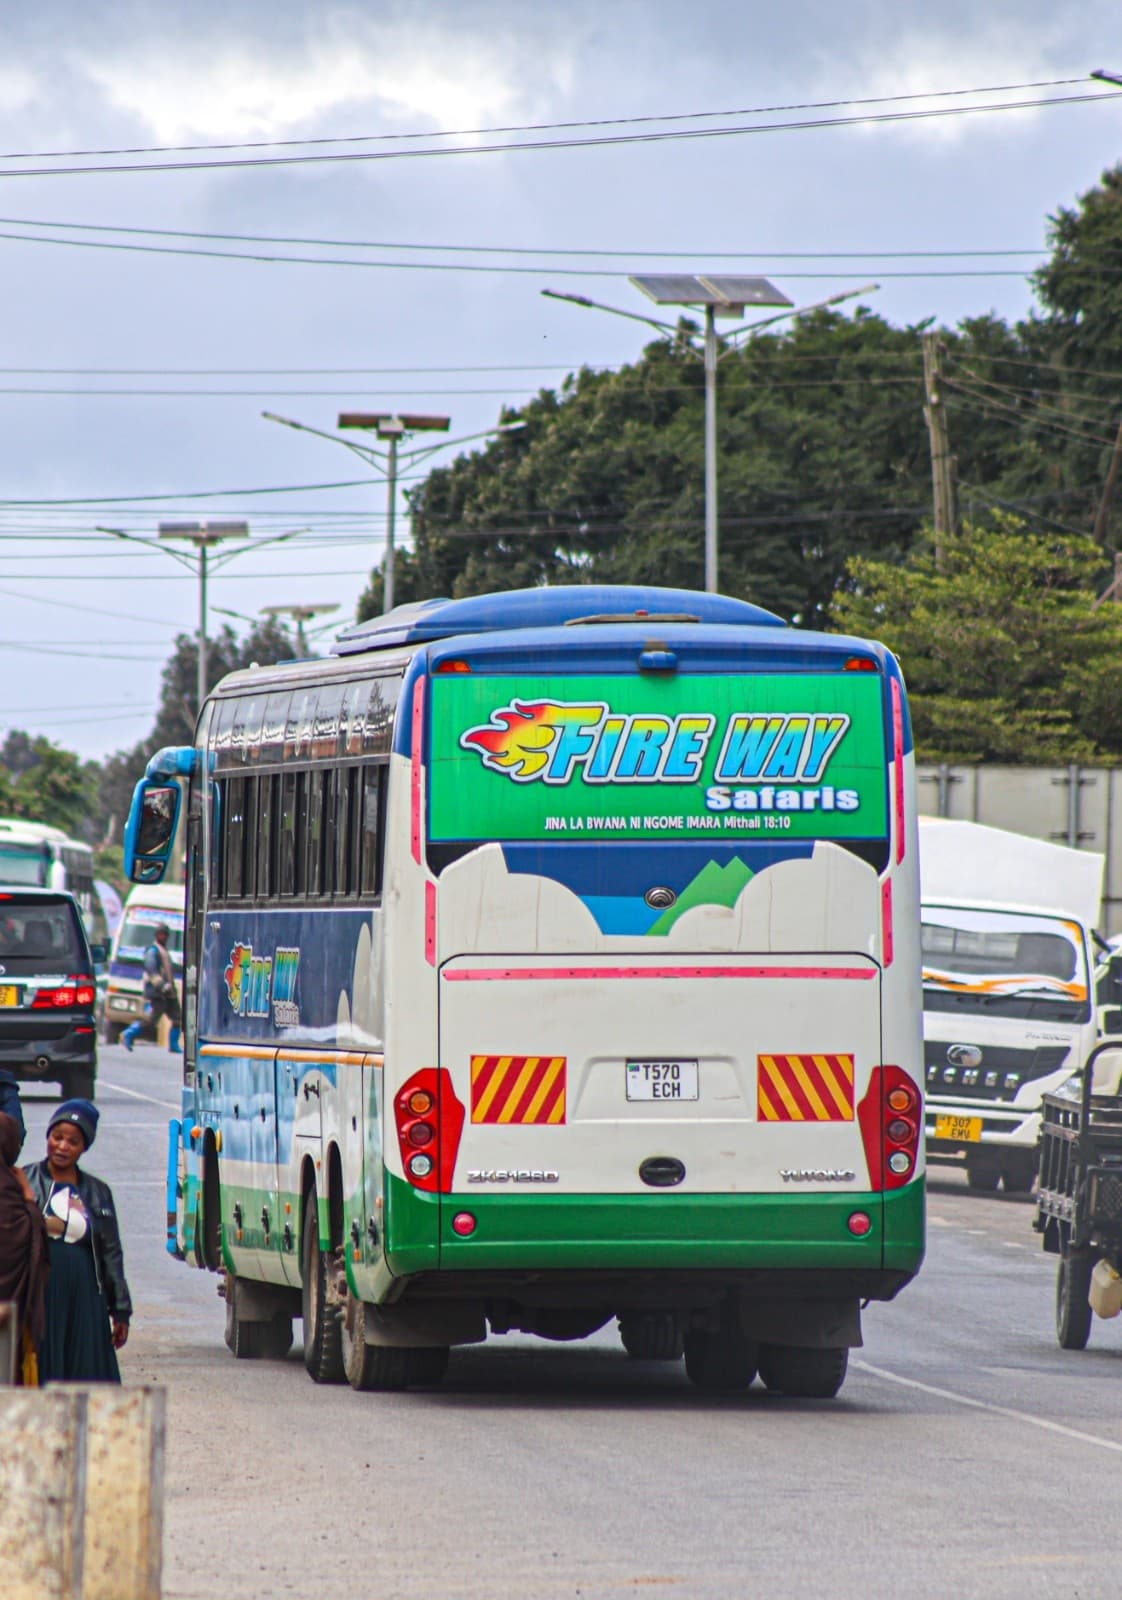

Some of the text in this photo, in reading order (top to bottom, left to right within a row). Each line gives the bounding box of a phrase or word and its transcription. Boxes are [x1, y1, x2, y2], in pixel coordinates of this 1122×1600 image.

[460, 698, 850, 784] FIRE WAY
[706, 786, 859, 810] Safaris
[544, 816, 790, 830] JINA LA BWANA NI NGOME IMARA Mithali 18:10
[642, 1064, 680, 1080] T570
[927, 1065, 1021, 1089] ICHER
[652, 1082, 681, 1098] ECH
[779, 1168, 856, 1182] YUTONG
